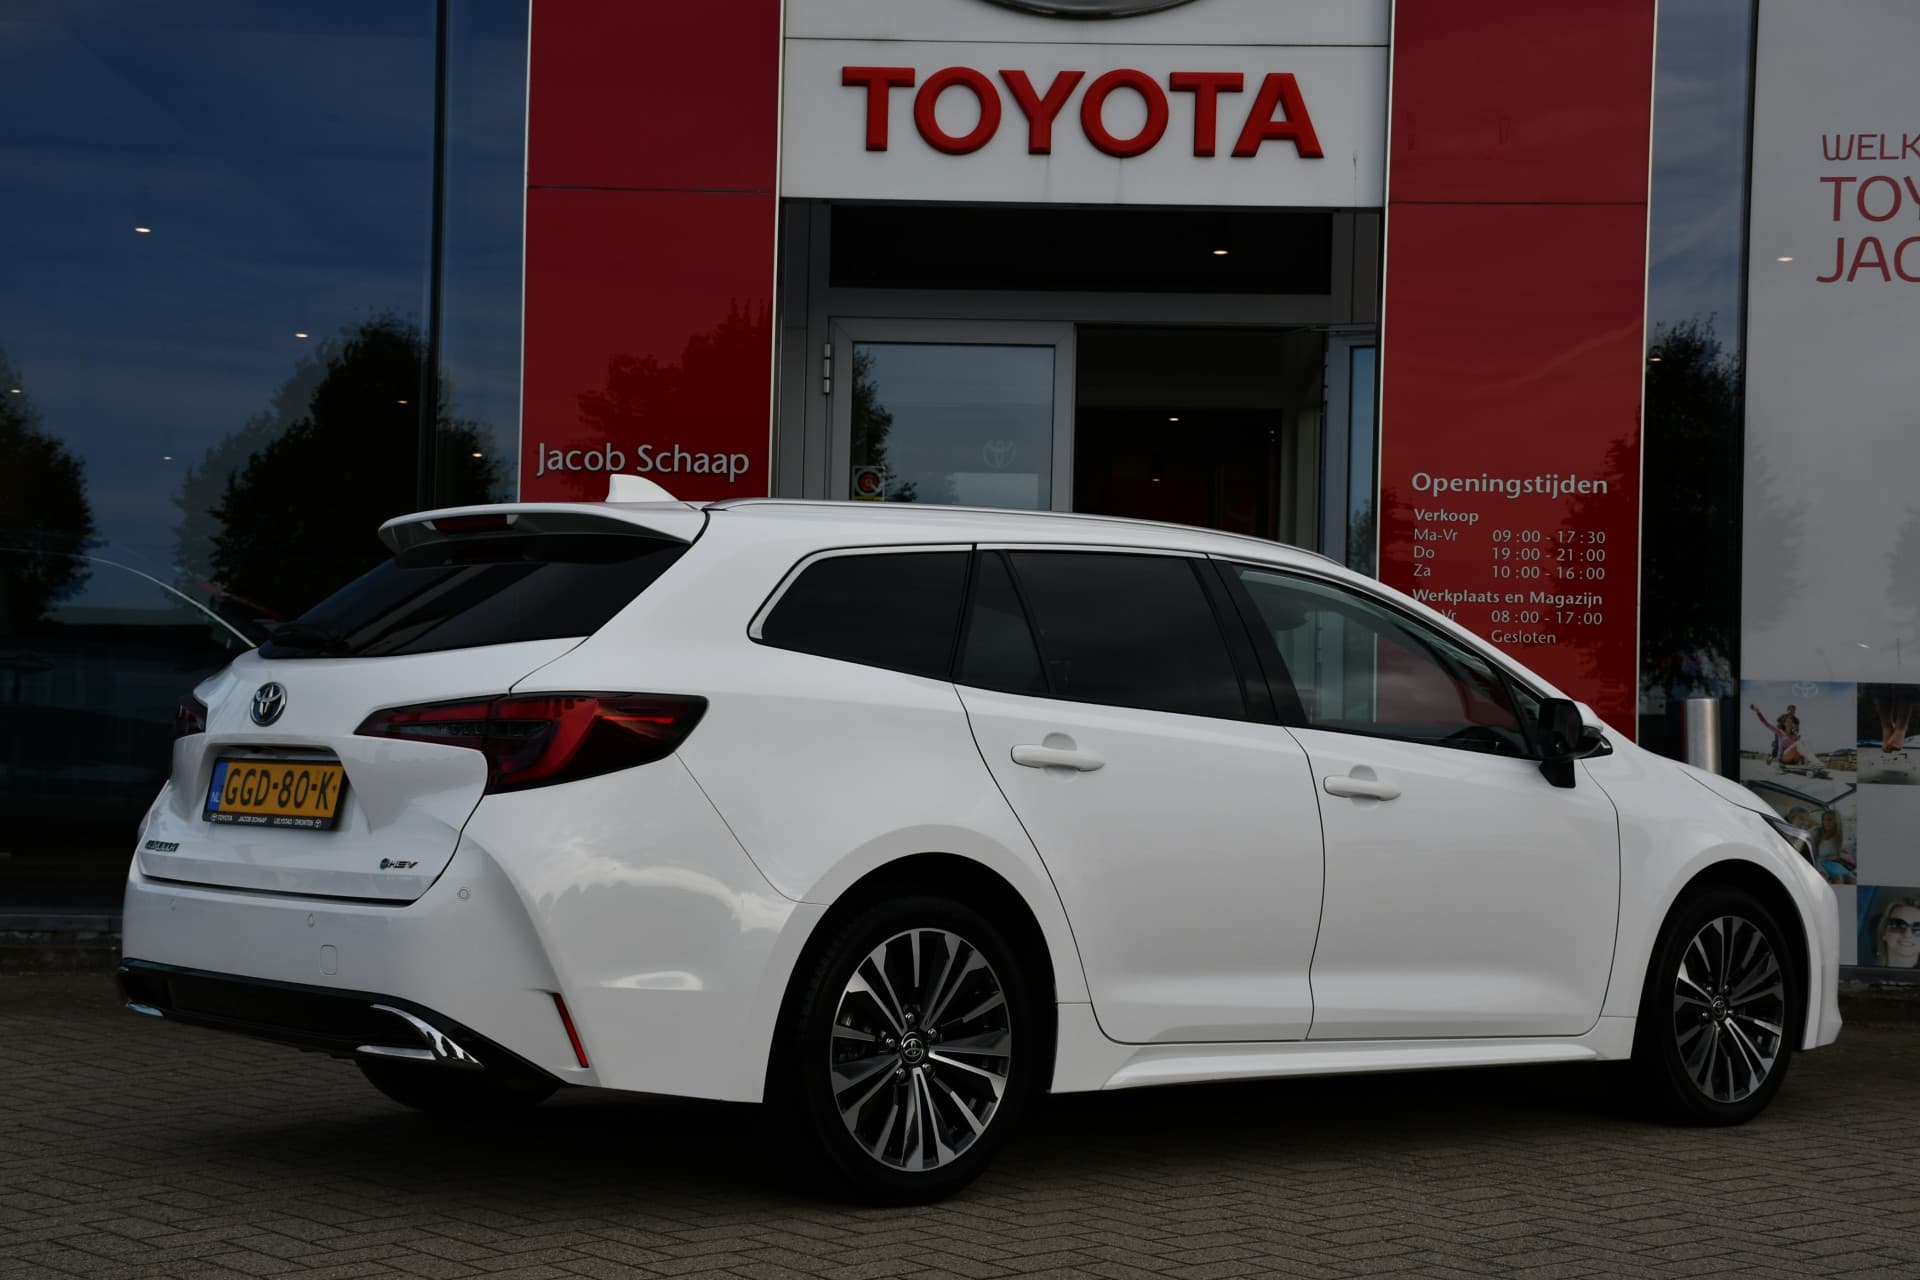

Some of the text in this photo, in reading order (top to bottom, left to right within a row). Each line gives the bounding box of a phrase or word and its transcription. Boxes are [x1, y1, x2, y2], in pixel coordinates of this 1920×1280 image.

[842, 66, 1324, 158] TOYOTA
[1822, 133, 1920, 161] WELK
[537, 443, 749, 482] Jacob Schaap
[1411, 472, 1608, 499] Openingstijden
[1413, 508, 1479, 525] Verkoop
[1413, 528, 1458, 541] Ma-Vr
[1413, 545, 1435, 559] Do
[1413, 563, 1431, 577] Za
[1412, 588, 1603, 609] Werkplaats en Magazijn
[1490, 629, 1556, 645] Gesloten
[225, 767, 334, 810] GGD-80-K
